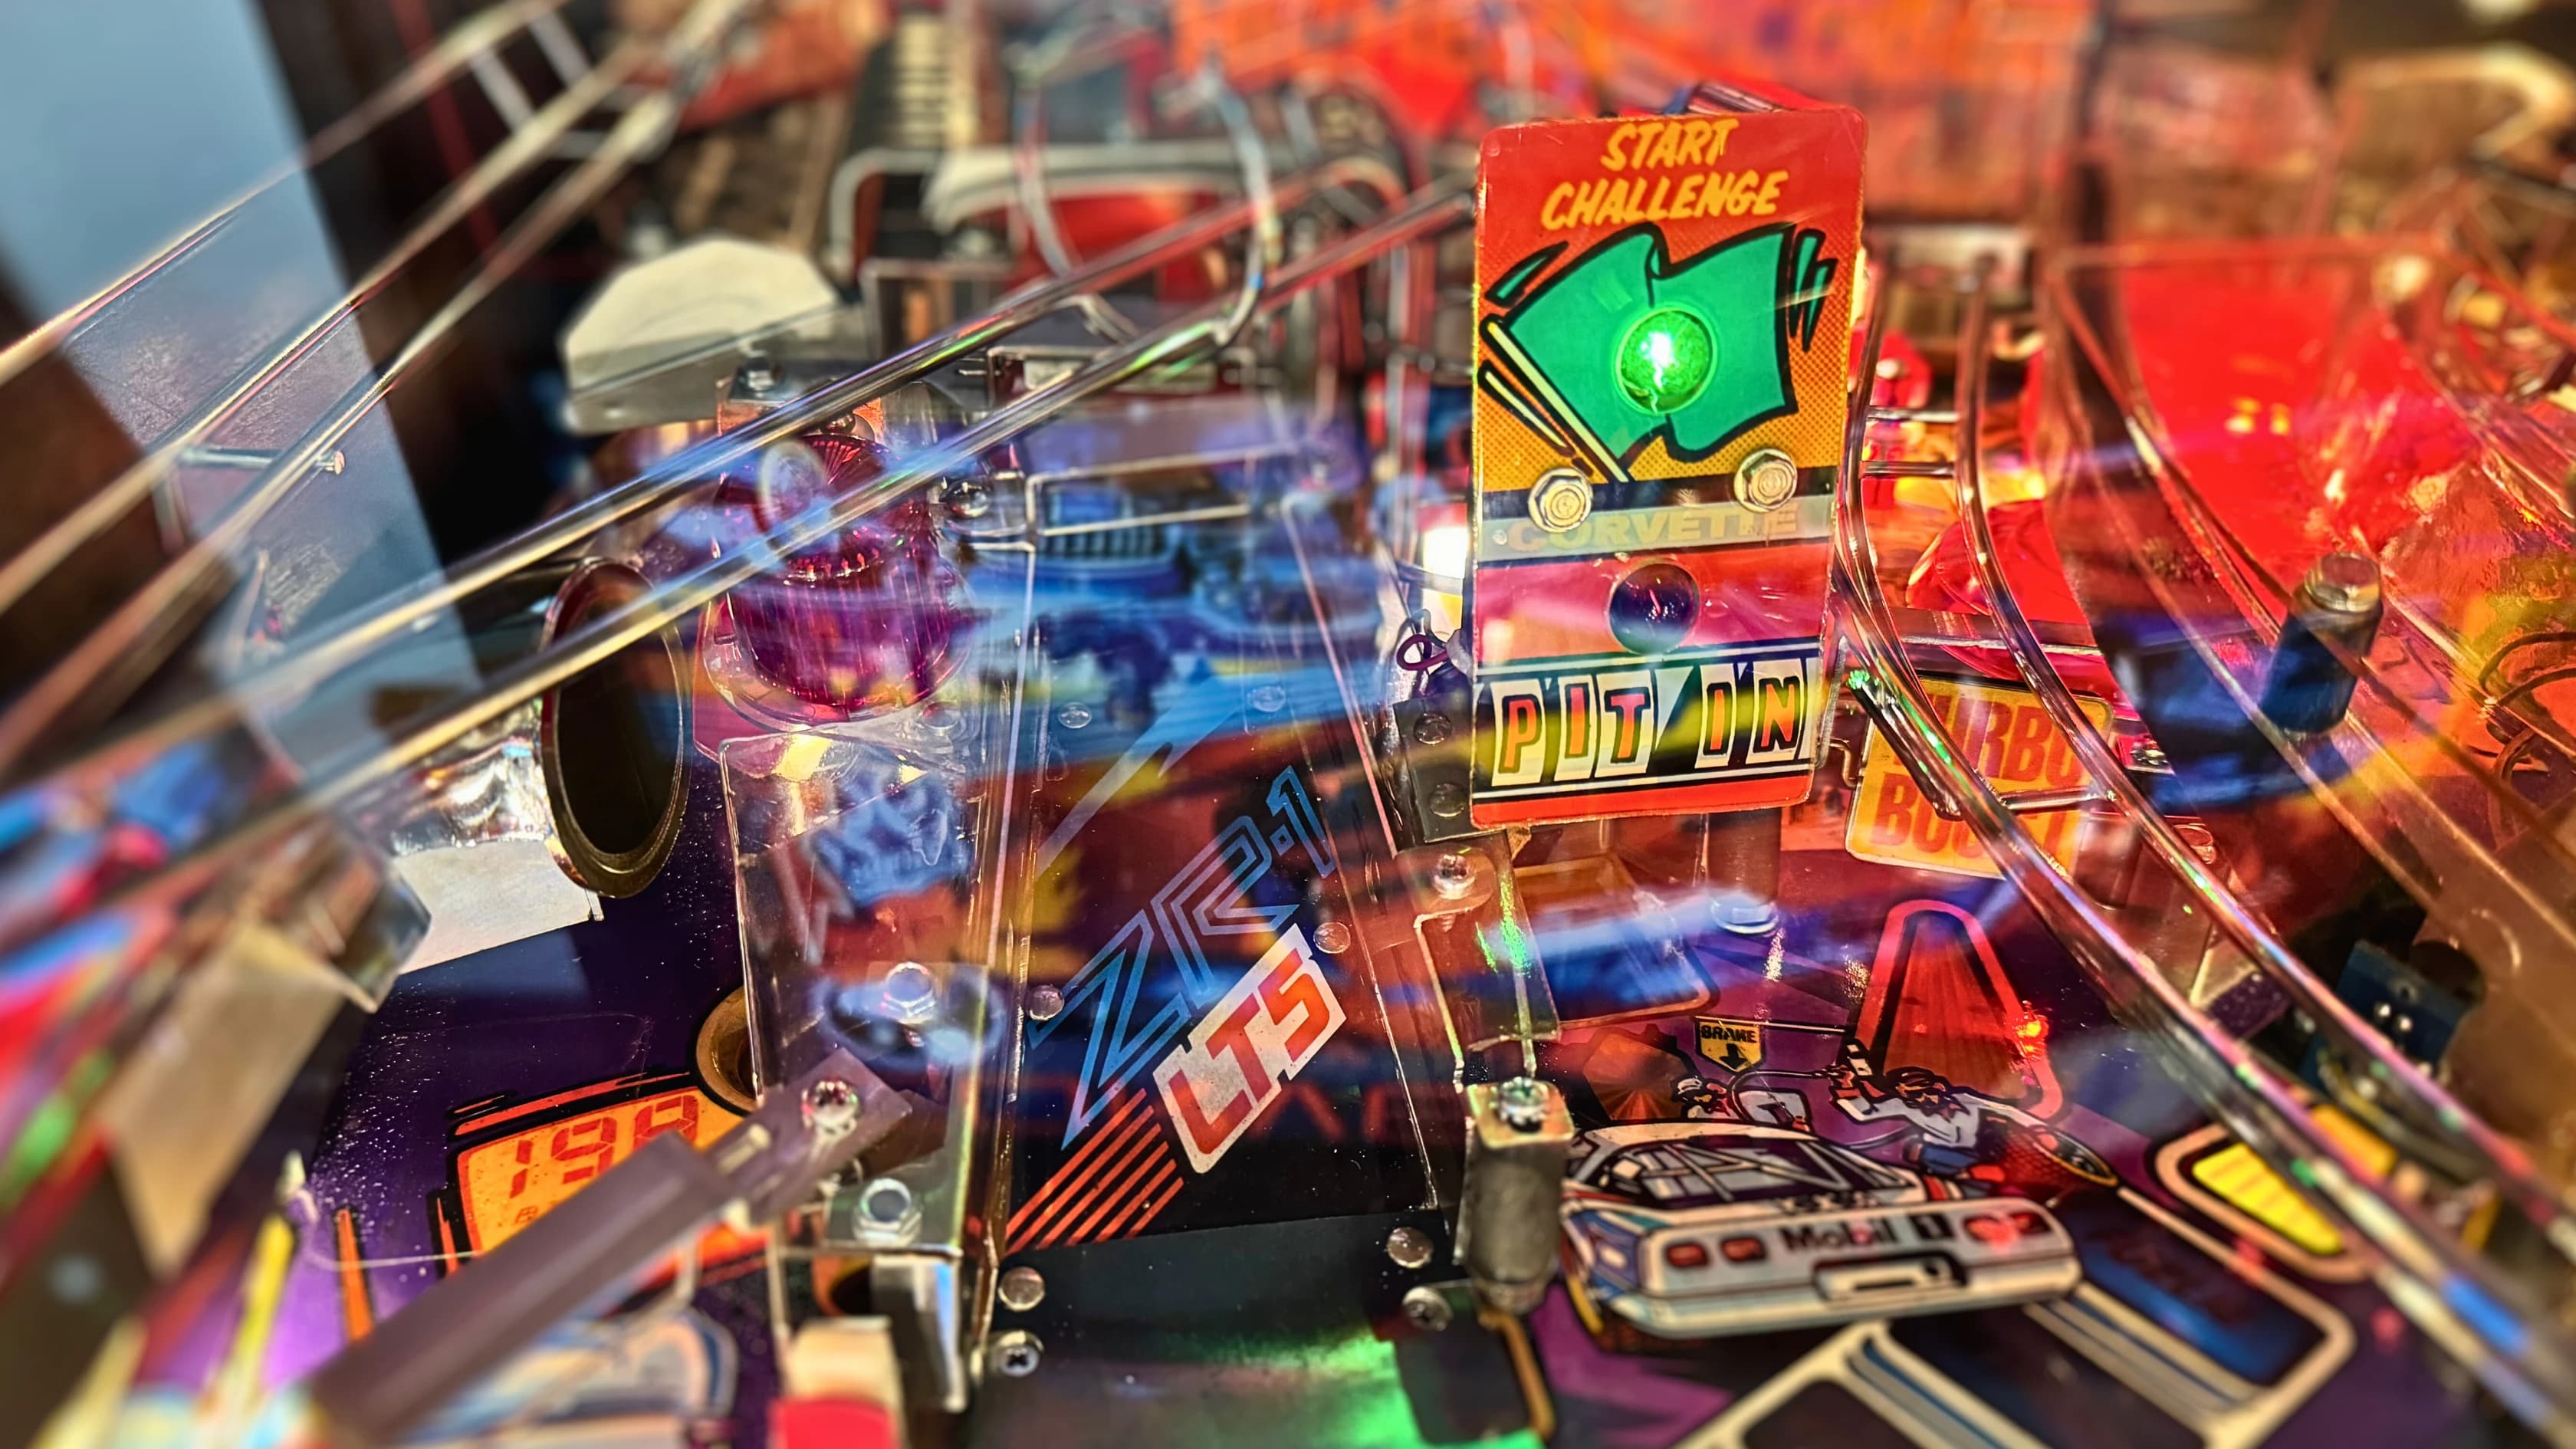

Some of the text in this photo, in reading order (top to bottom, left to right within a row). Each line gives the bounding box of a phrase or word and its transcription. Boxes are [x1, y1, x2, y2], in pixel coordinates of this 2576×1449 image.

[1600, 118, 1739, 172] START
[1540, 170, 1789, 230] CHALLENGE
[1506, 501, 1799, 554] CORVETTE
[1497, 676, 1807, 774] PIT IN
[1700, 1024, 1757, 1043] BRAKE
